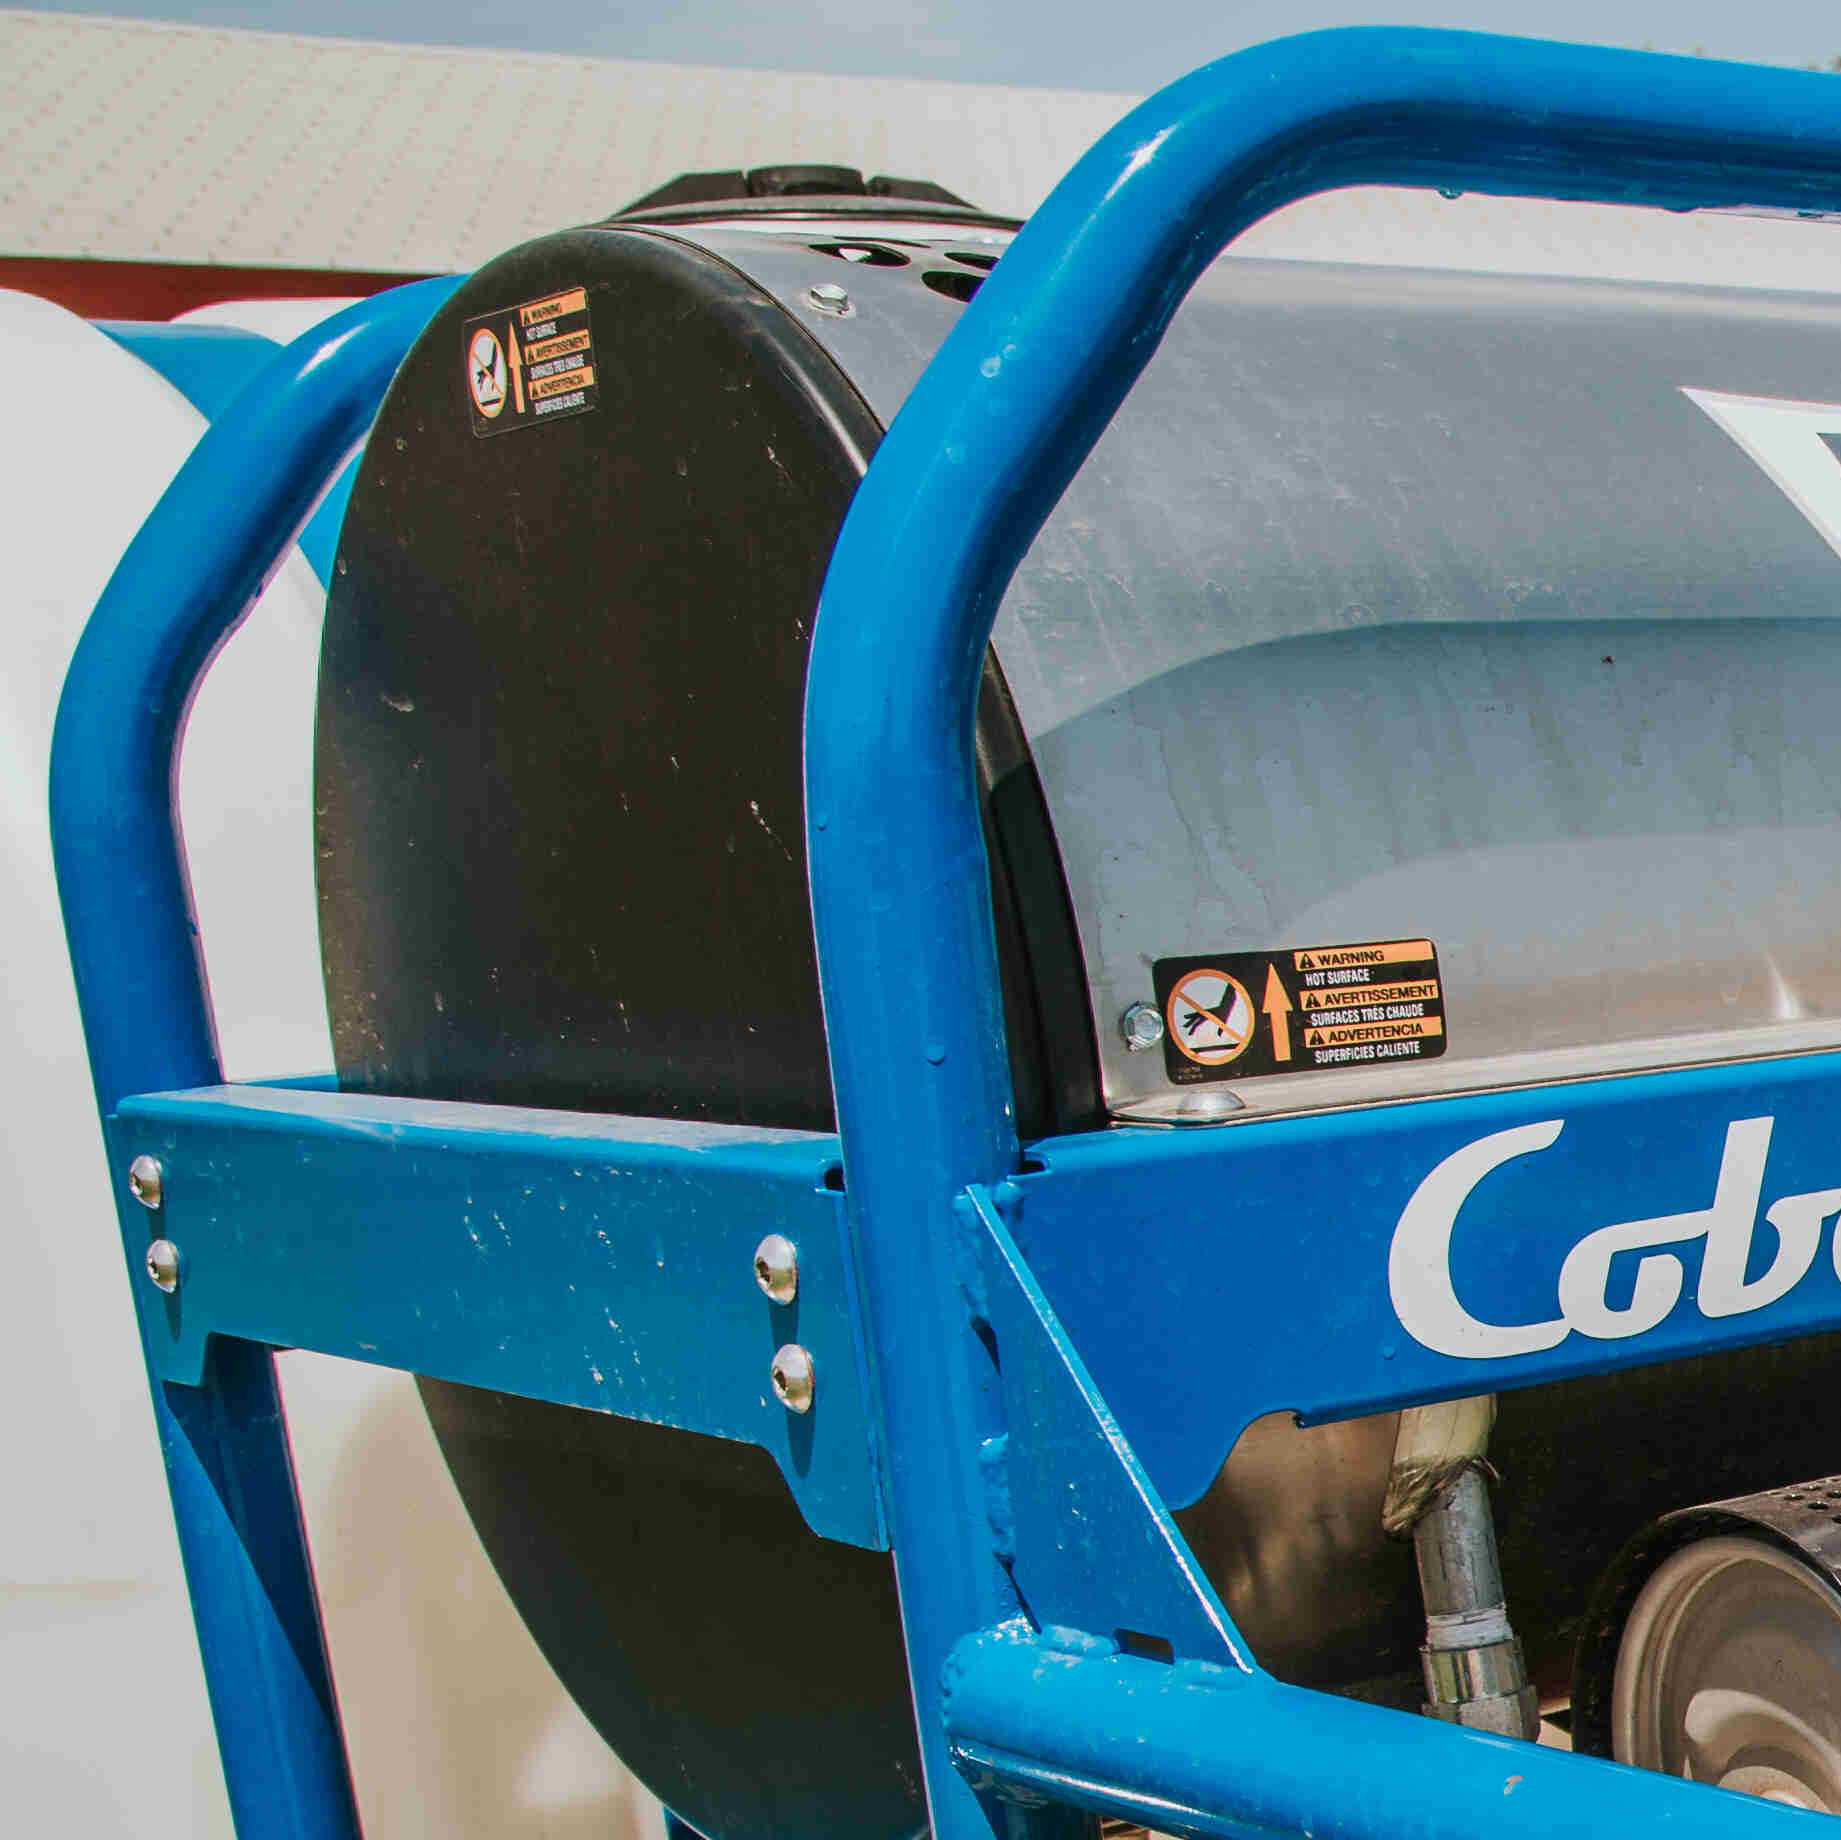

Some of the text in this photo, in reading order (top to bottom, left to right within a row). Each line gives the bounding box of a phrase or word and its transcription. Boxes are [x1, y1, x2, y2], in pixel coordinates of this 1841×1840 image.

[1317, 950, 1385, 967] WARNING
[1305, 968, 1371, 987] HOT SURFACE
[1324, 984, 1436, 1006] AVERTISSEMENT
[1310, 1008, 1360, 1027] SURFACES
[1386, 1003, 1425, 1019] CHAUDE
[1328, 1022, 1424, 1044] ADVERTENCIA
[1314, 1041, 1421, 1064] SUPERFICIES CALIENTE
